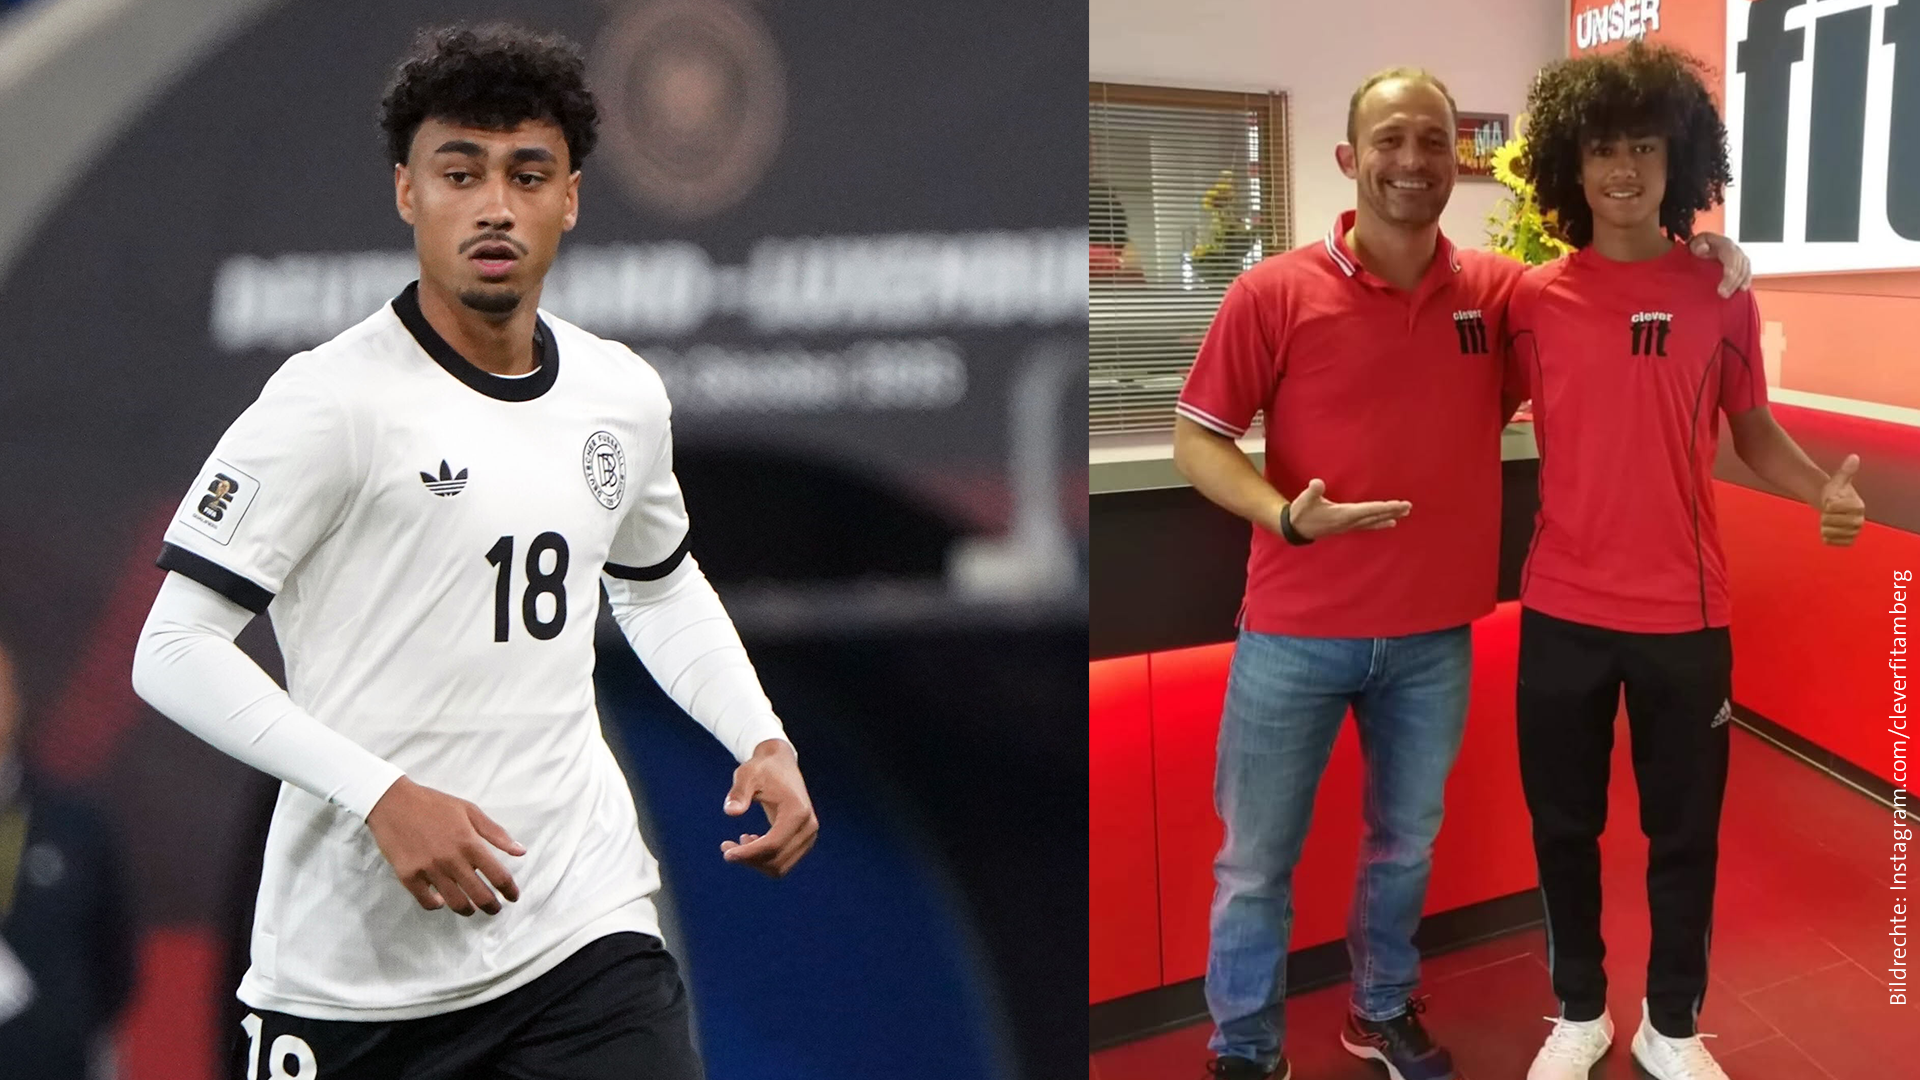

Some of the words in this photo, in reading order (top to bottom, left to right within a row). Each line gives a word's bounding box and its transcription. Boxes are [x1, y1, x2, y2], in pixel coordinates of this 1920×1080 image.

[1576, 0, 1660, 49] UNSER
[1453, 309, 1482, 321] clever
[1631, 311, 1674, 323] clever
[1630, 320, 1671, 357] fit
[485, 531, 569, 642] 18
[241, 1012, 318, 1080] 18
